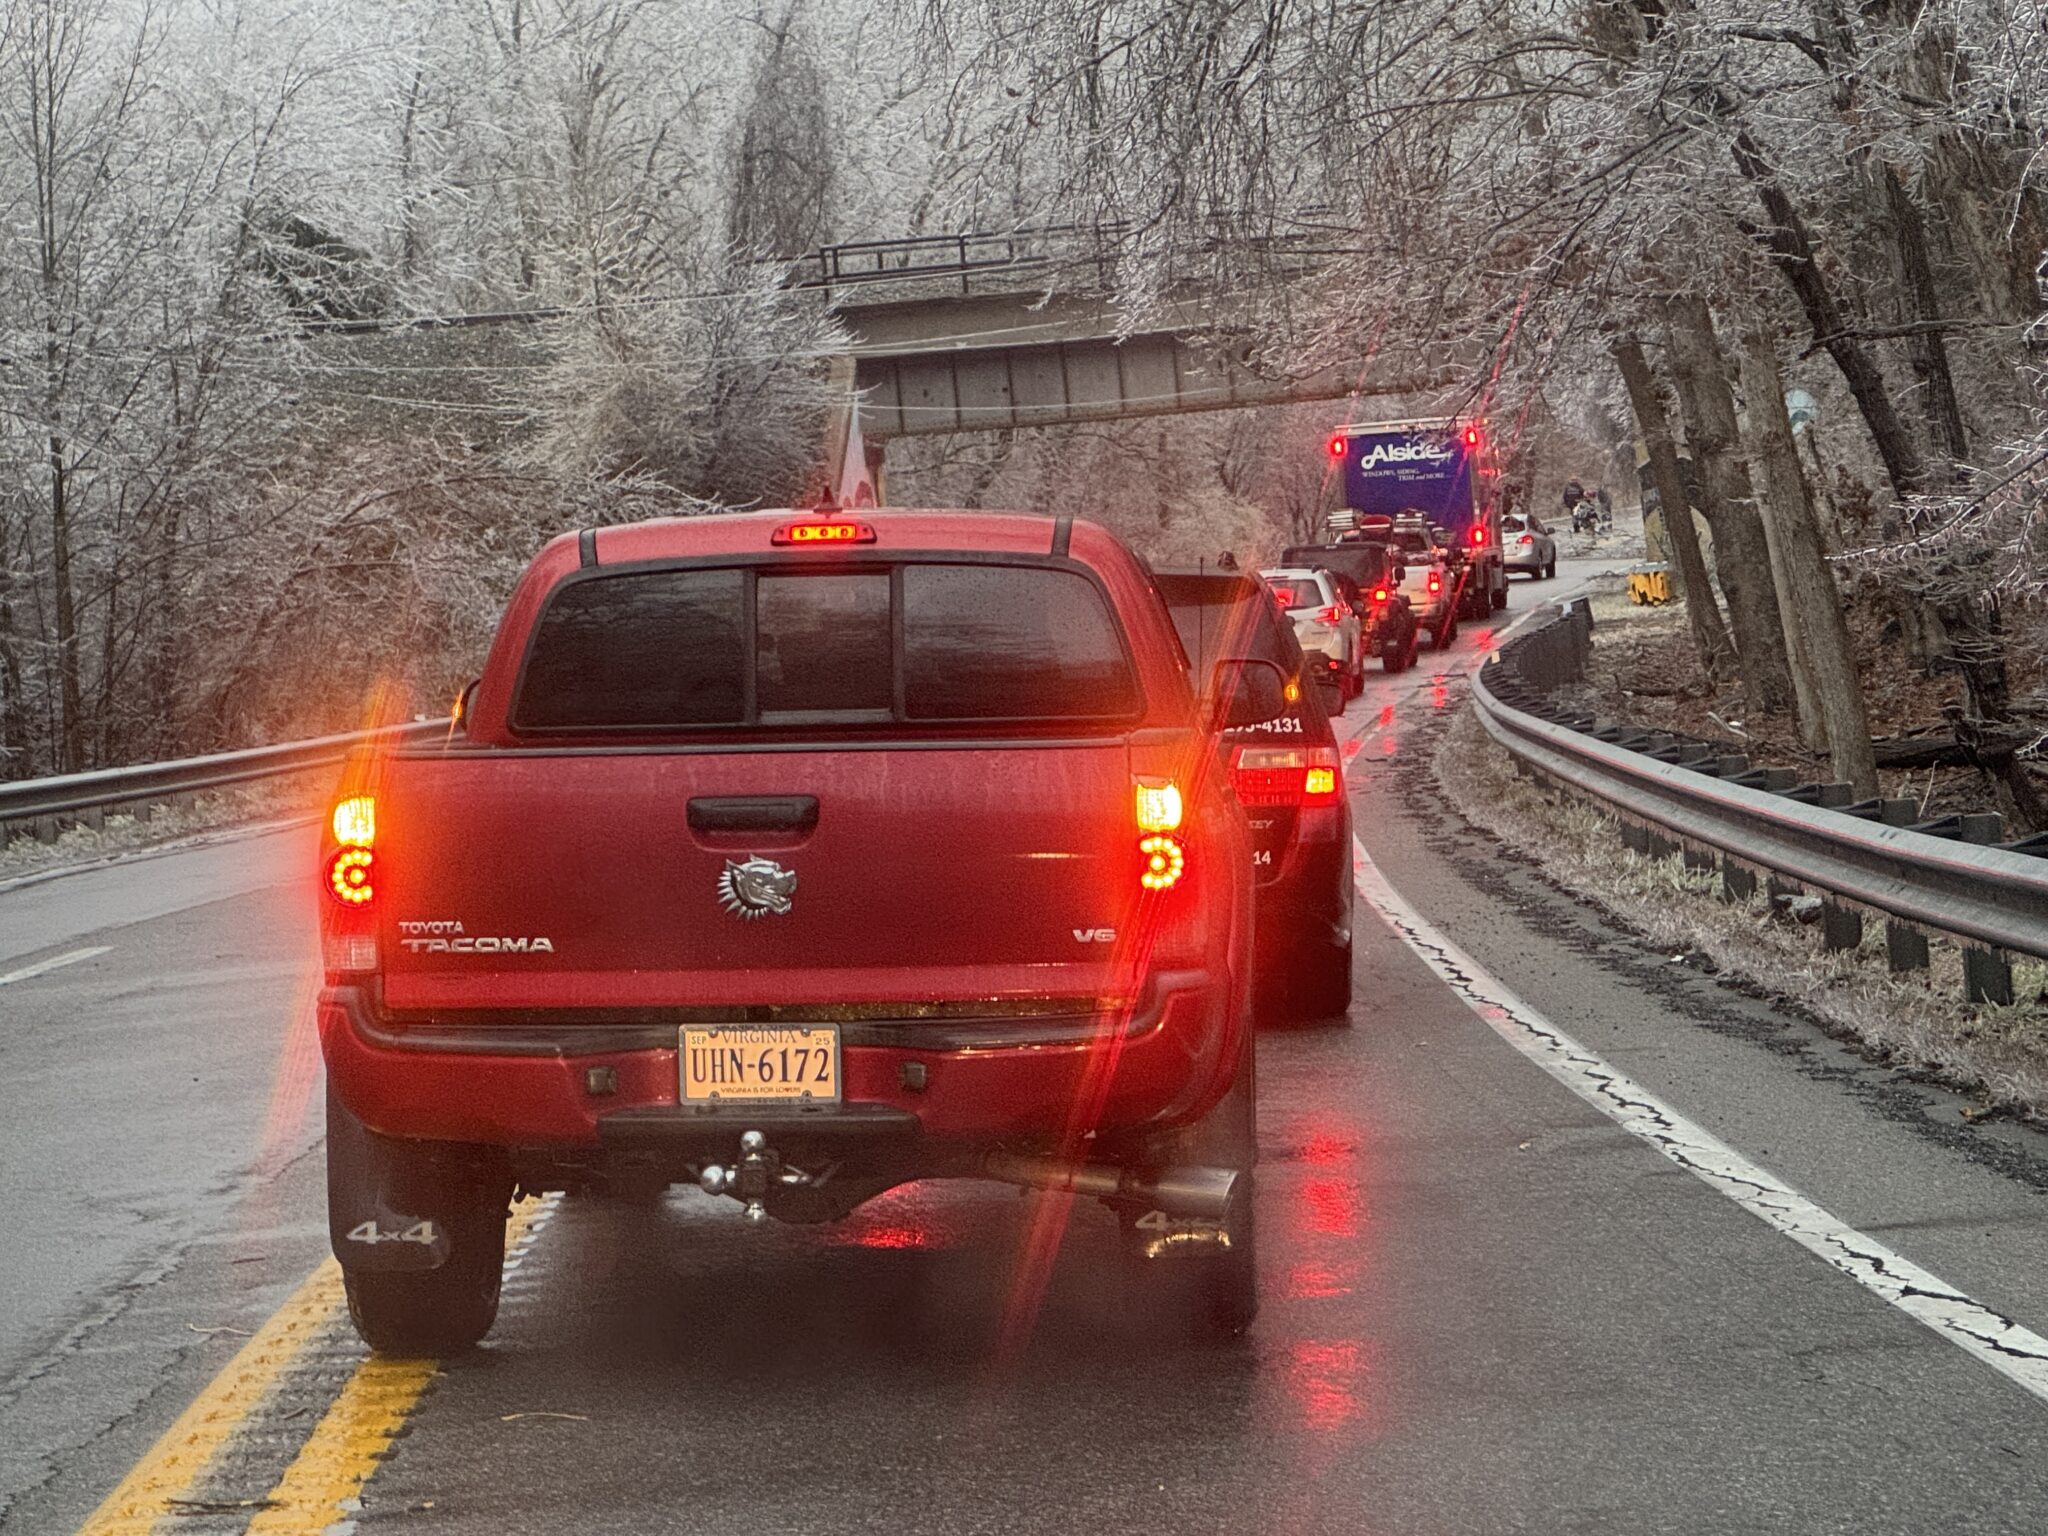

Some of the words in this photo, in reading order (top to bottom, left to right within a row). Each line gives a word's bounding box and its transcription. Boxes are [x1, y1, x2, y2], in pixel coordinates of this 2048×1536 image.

[1361, 441, 1450, 470] Alside
[398, 920, 465, 935] TOYOTA
[1072, 928, 1117, 943] V6
[400, 937, 555, 953] TACOMA
[691, 1035, 707, 1045] SEP
[718, 1030, 799, 1044] VIRGINIA
[815, 1037, 831, 1046] 25
[691, 1047, 831, 1084] UHN-6172
[720, 1086, 751, 1094] VIRGINIA
[760, 1086, 775, 1094] FOR
[346, 1220, 438, 1245] 4x4
